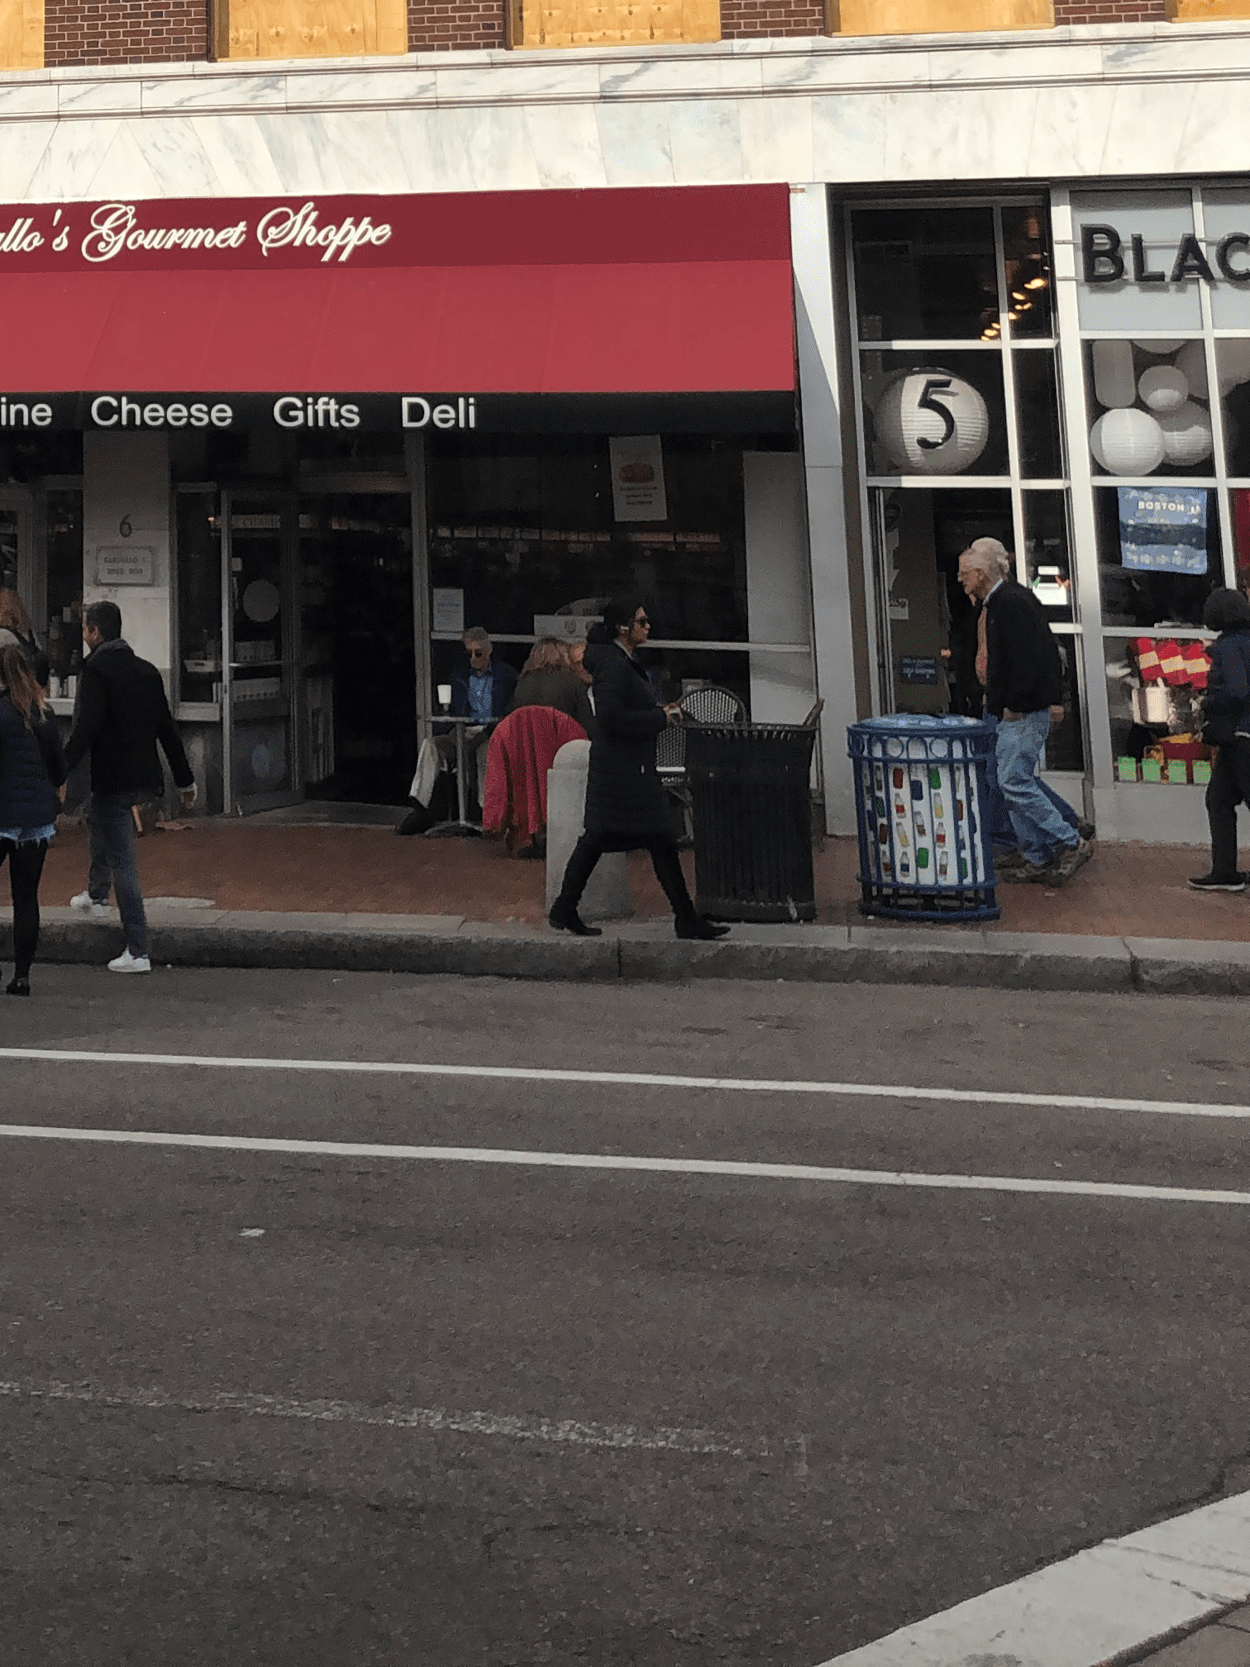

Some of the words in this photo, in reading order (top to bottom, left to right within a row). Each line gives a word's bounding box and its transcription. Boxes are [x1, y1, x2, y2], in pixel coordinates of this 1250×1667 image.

[81, 203, 247, 263] Gourmet
[256, 201, 392, 262] Shoppe
[1080, 223, 1250, 283] BLAC
[90, 395, 234, 427] Cheese
[273, 396, 361, 428] Gifts
[400, 396, 476, 429] Deli
[916, 379, 955, 449] 5
[119, 514, 132, 538] 6
[1138, 501, 1185, 512] BOSTON
